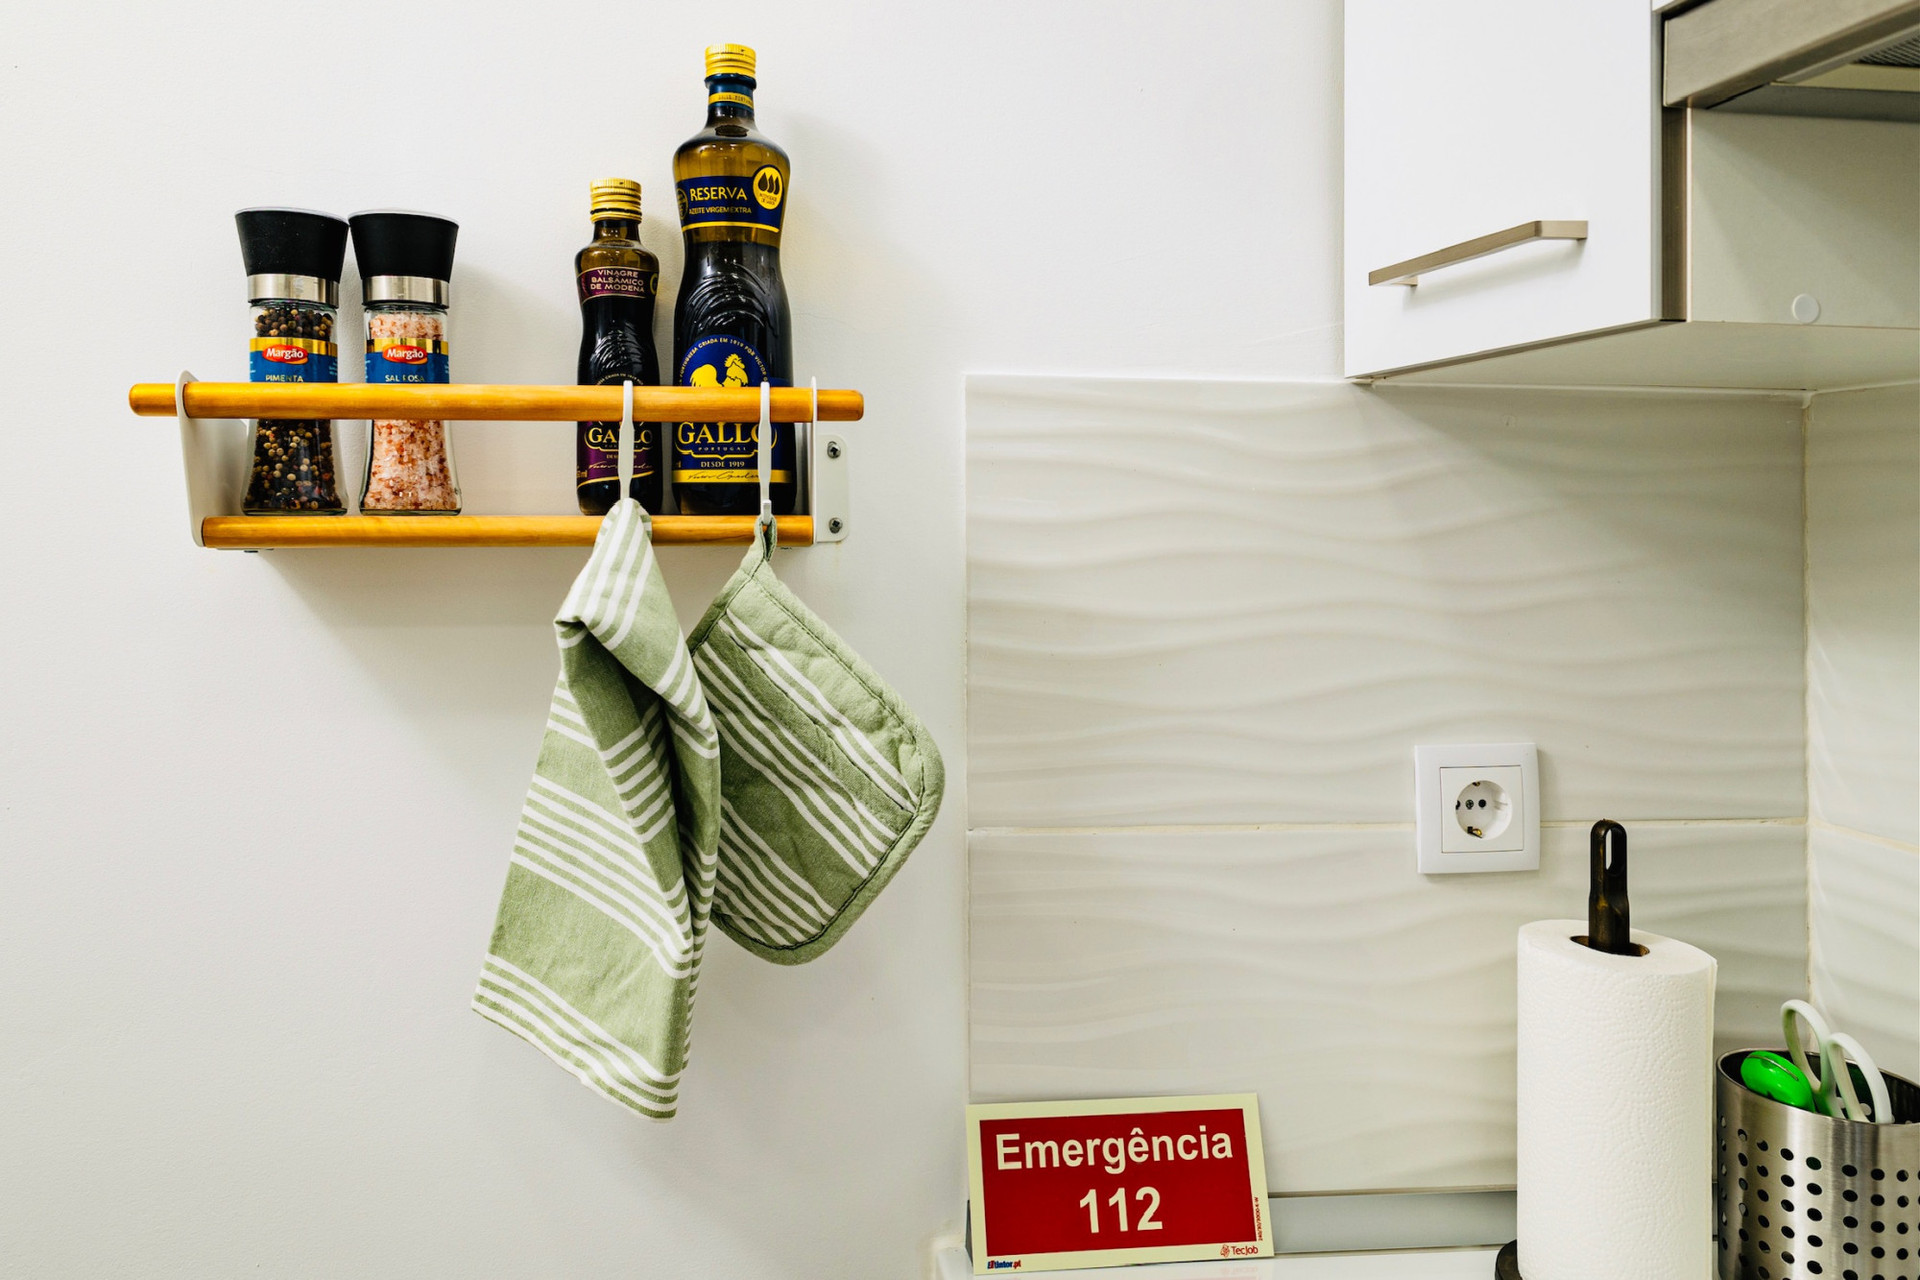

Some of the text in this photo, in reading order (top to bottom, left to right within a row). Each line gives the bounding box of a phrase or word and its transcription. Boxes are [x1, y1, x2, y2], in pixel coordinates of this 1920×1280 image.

[689, 186, 748, 202] RESERVA
[705, 206, 729, 215] VIRGEM
[730, 206, 752, 215] EXTRA
[597, 269, 639, 278] VINAGRE
[604, 284, 645, 293] MODENA
[698, 338, 718, 349] CRIADA
[266, 347, 305, 360] Margão
[386, 347, 424, 360] Margão
[265, 374, 304, 383] PIMENTA
[384, 374, 400, 383] SAL
[588, 427, 653, 444] GAO
[996, 1125, 1233, 1175] Emergência
[1079, 1186, 1164, 1234] 112
